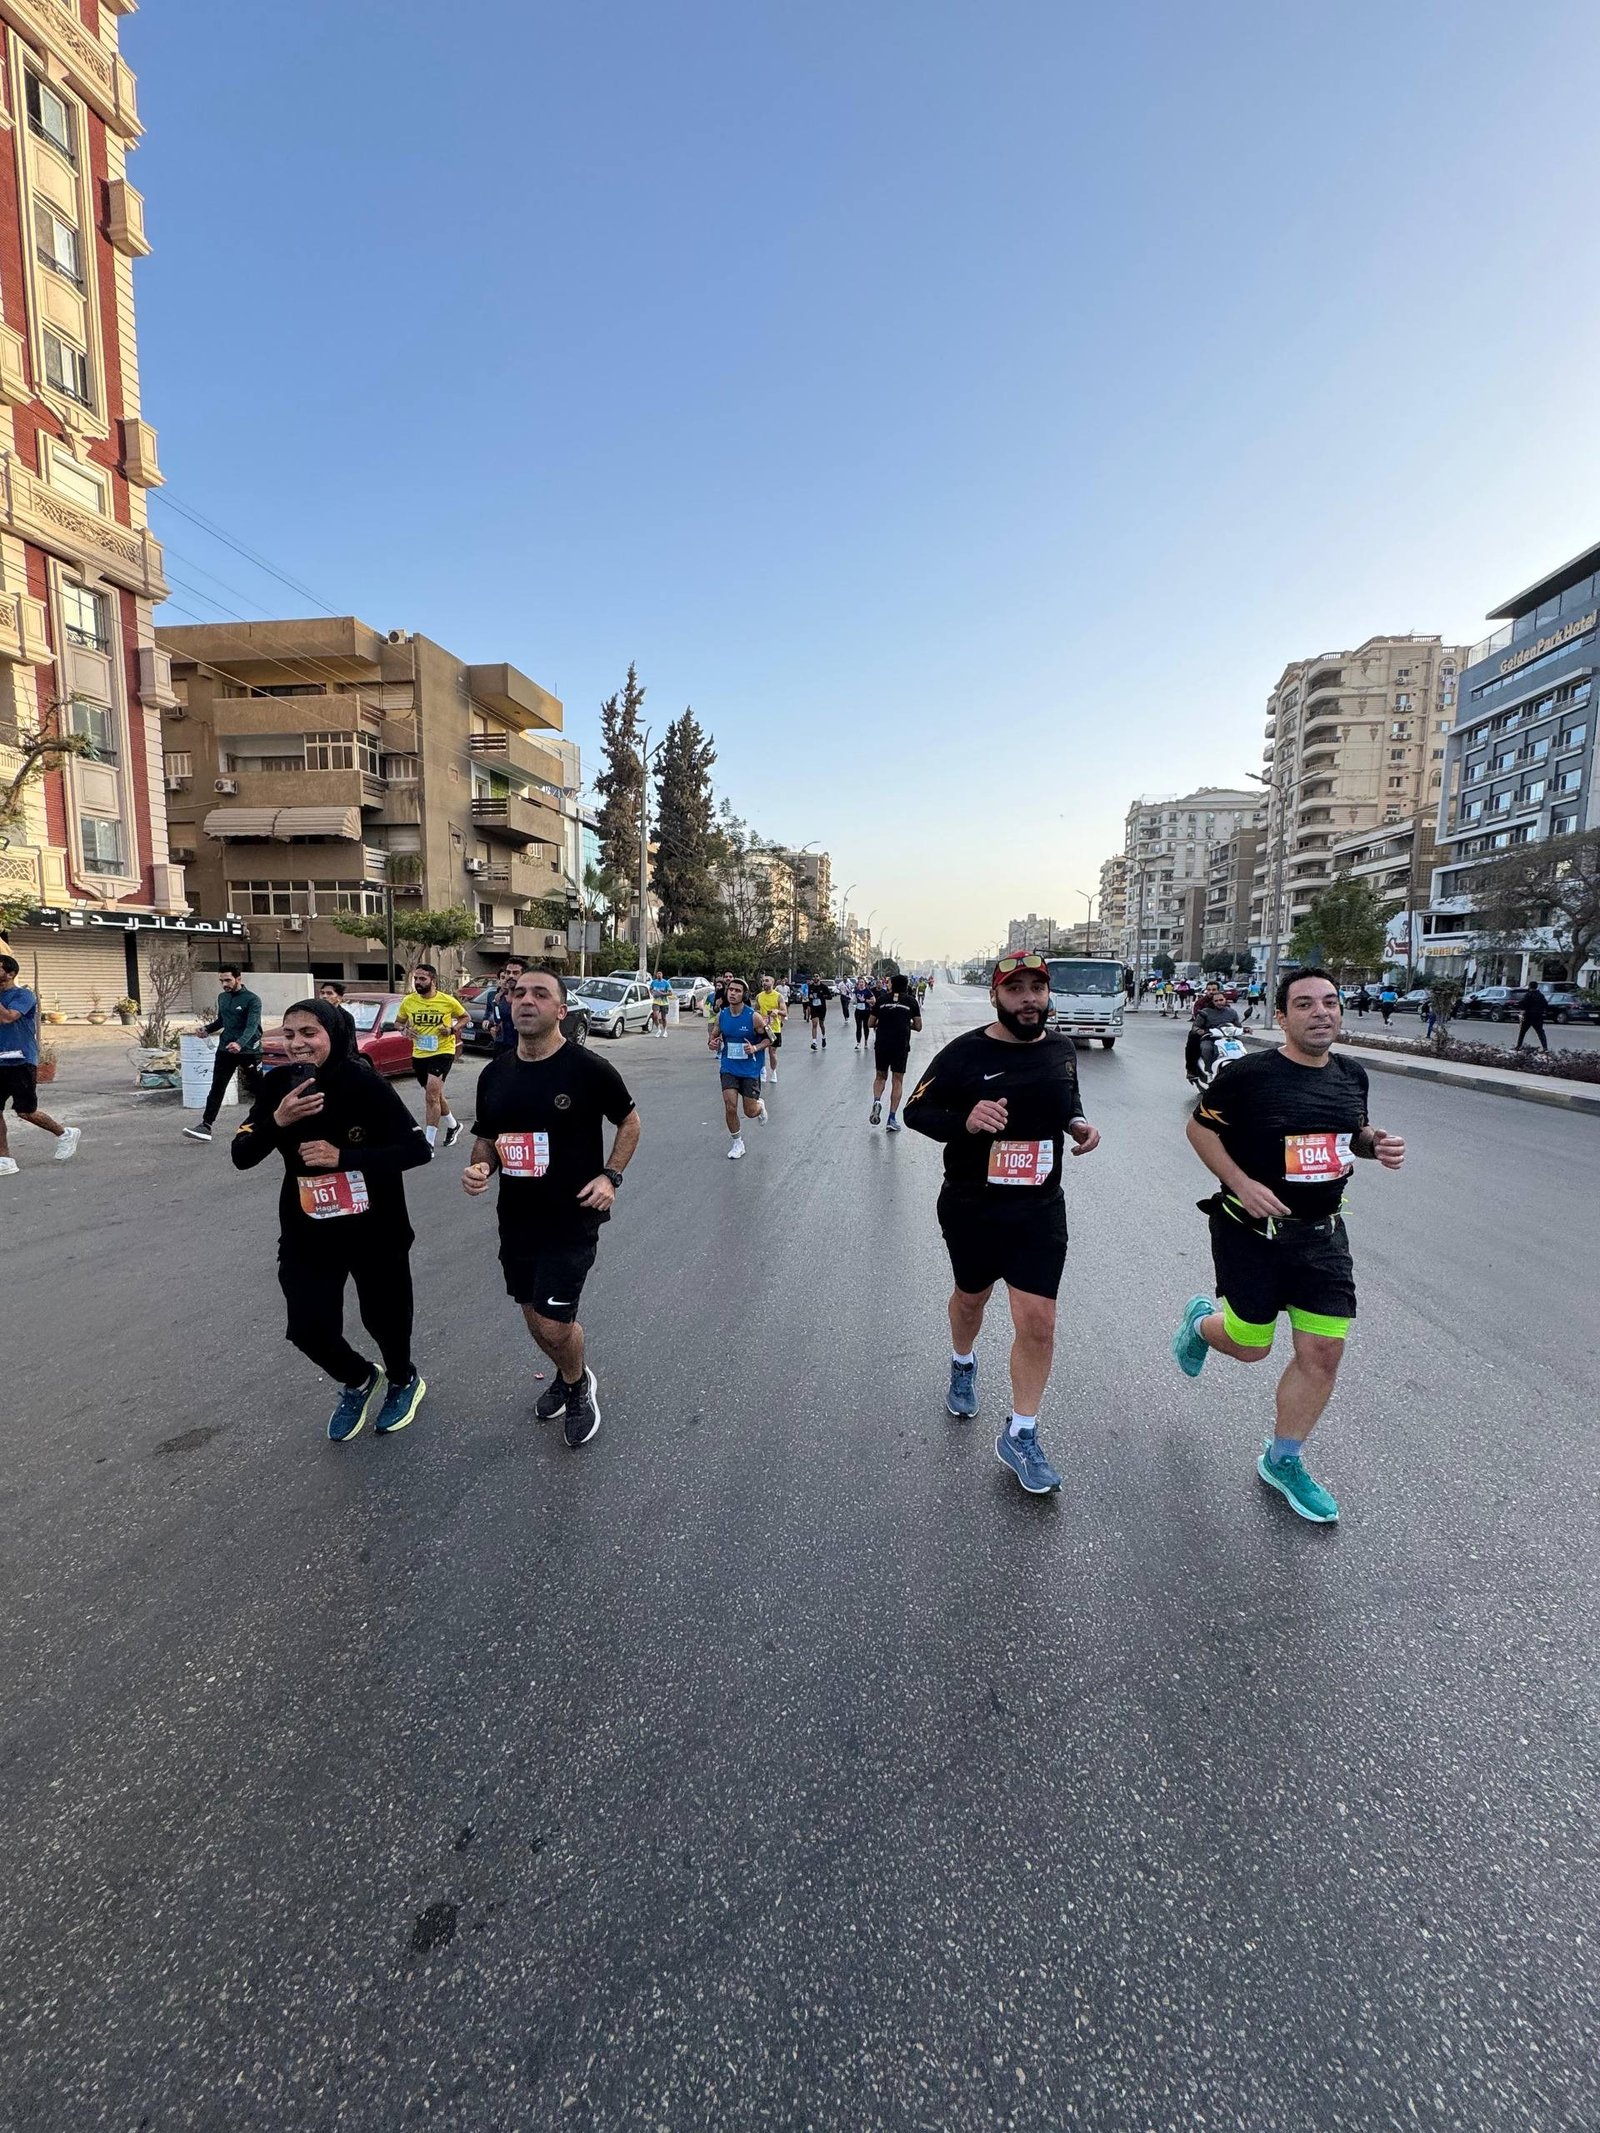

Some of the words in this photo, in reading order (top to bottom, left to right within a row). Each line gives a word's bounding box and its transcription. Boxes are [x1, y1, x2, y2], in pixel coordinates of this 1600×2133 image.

[1501, 644, 1537, 673] Golden
[1537, 629, 1564, 653] Park
[1563, 609, 1598, 638] Hotel
[414, 1013, 444, 1023] ELFIT
[996, 1152, 1033, 1168] 11082
[1297, 1147, 1331, 1164] 1944
[313, 1186, 337, 1203] 161
[315, 1204, 340, 1212] Hagar
